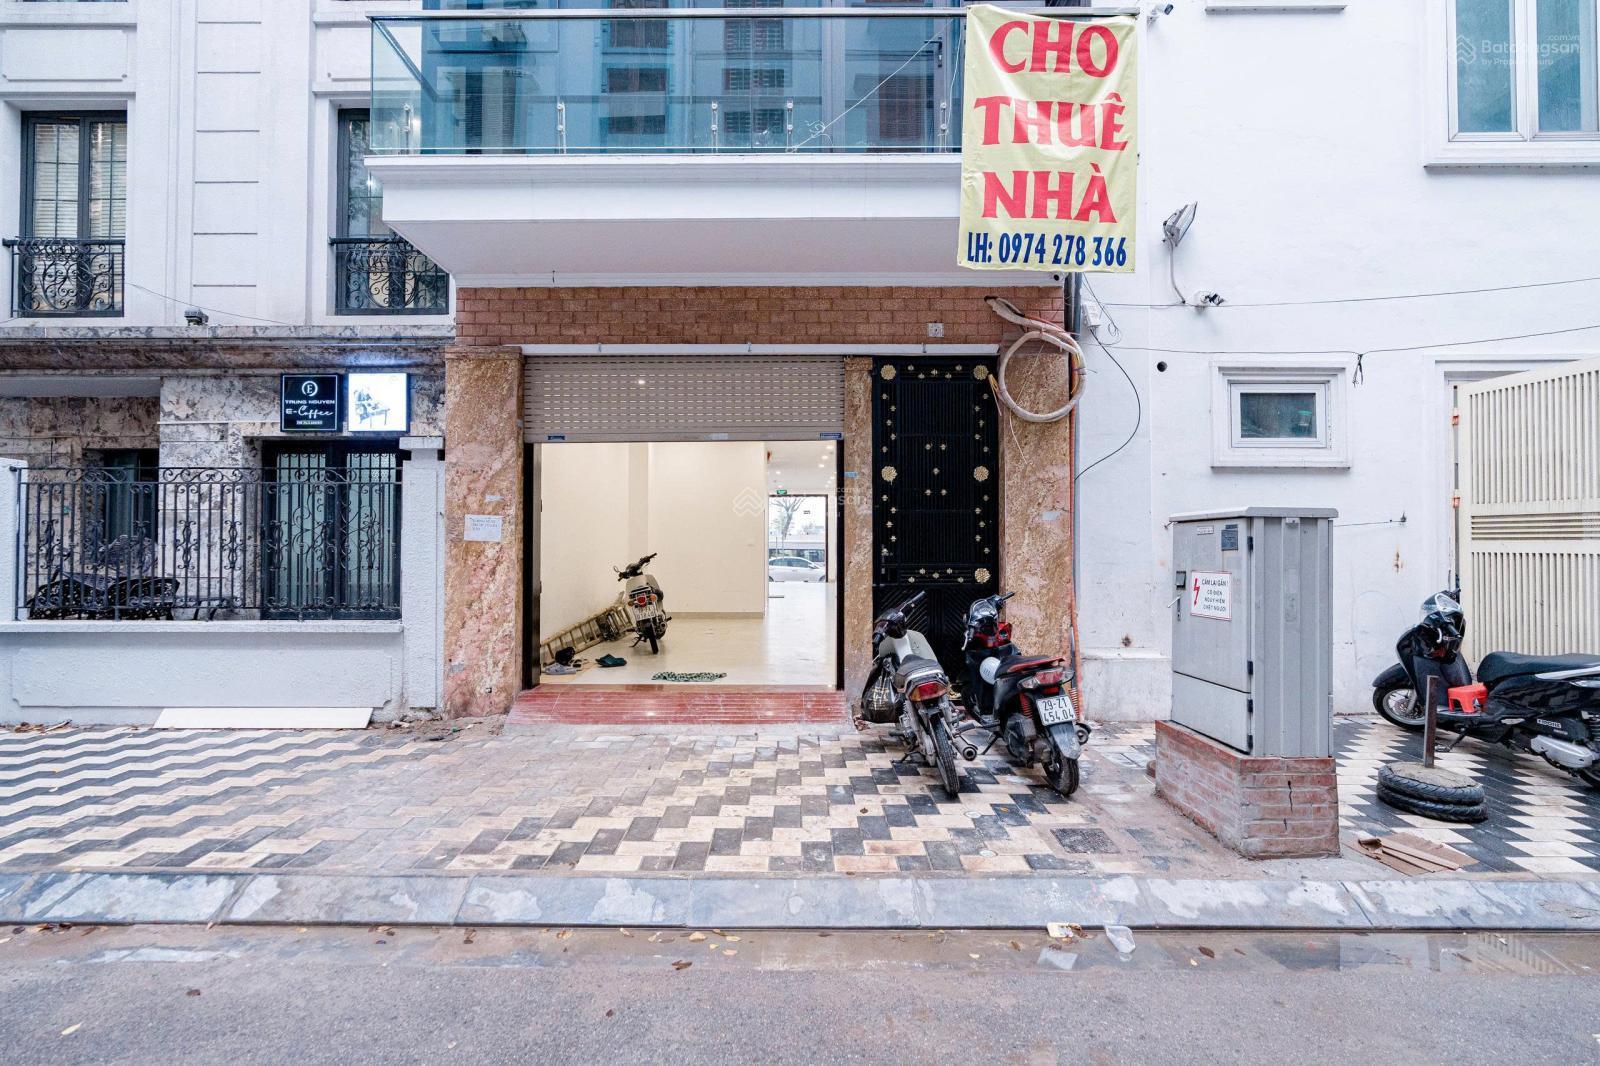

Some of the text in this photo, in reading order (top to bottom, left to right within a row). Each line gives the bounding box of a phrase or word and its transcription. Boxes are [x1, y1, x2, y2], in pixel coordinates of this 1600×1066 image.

[989, 20, 1119, 77] CHO
[973, 92, 1128, 151] THUÊ
[981, 162, 1118, 224] NHÀ
[967, 231, 1127, 267] LH: 0974 278 366
[285, 405, 334, 419] E-Coffee
[1044, 708, 1074, 722] 454.04
